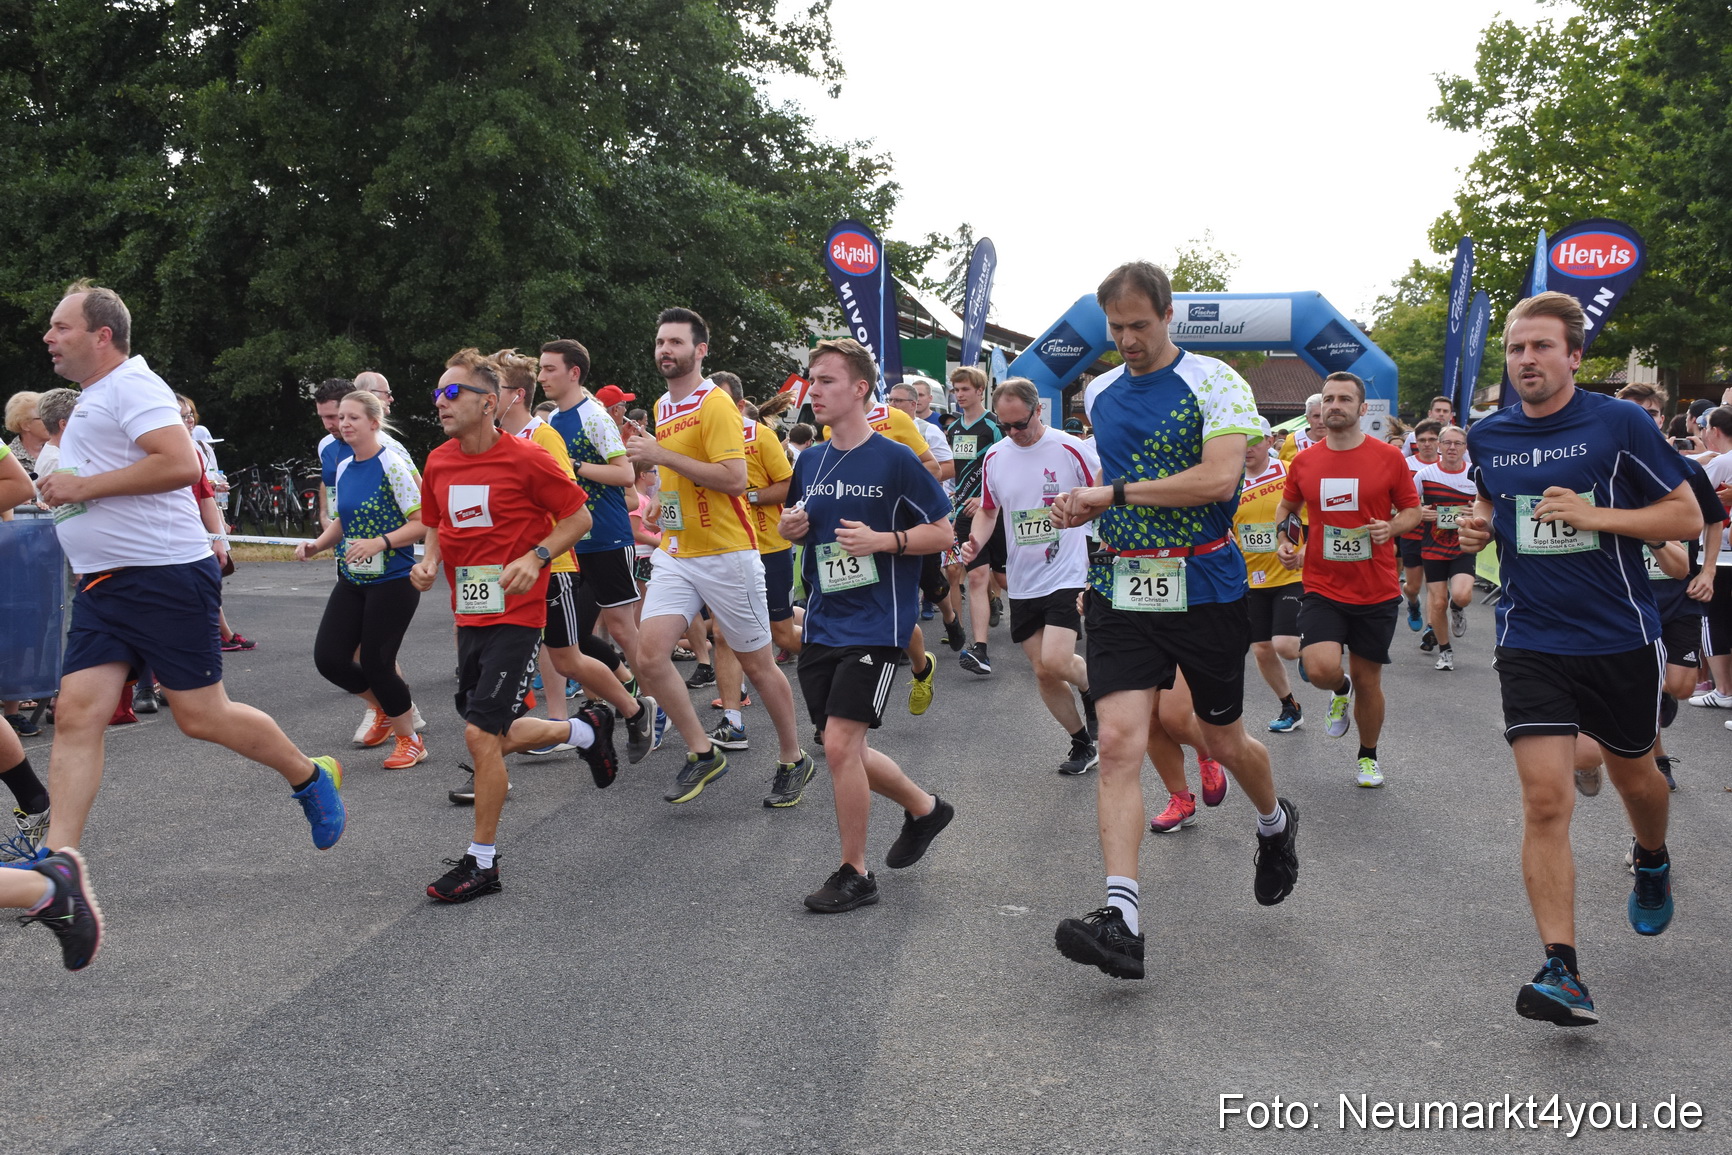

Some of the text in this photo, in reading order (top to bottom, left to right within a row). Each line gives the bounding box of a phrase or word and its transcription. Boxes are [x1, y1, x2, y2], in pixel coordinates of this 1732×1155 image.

[1559, 243, 1630, 268] Hervis
[1176, 321, 1245, 334] firmenlauf
[1048, 342, 1083, 353] Fischer
[656, 416, 701, 441] MAX BÖGL
[955, 443, 974, 453] 2182
[1492, 442, 1587, 468] EURO POLES
[806, 483, 884, 498] EURO POLES
[1238, 481, 1287, 506] AX BÖG
[660, 505, 677, 520] 86
[1018, 519, 1052, 536] 1778
[1530, 517, 1578, 538] 715
[1243, 533, 1272, 545] 1683
[1333, 539, 1361, 553] 543
[1157, 549, 1170, 558] NB
[825, 556, 860, 579] 713
[848, 573, 864, 581] Simon
[462, 582, 490, 600] 528
[1129, 576, 1169, 597] 215
